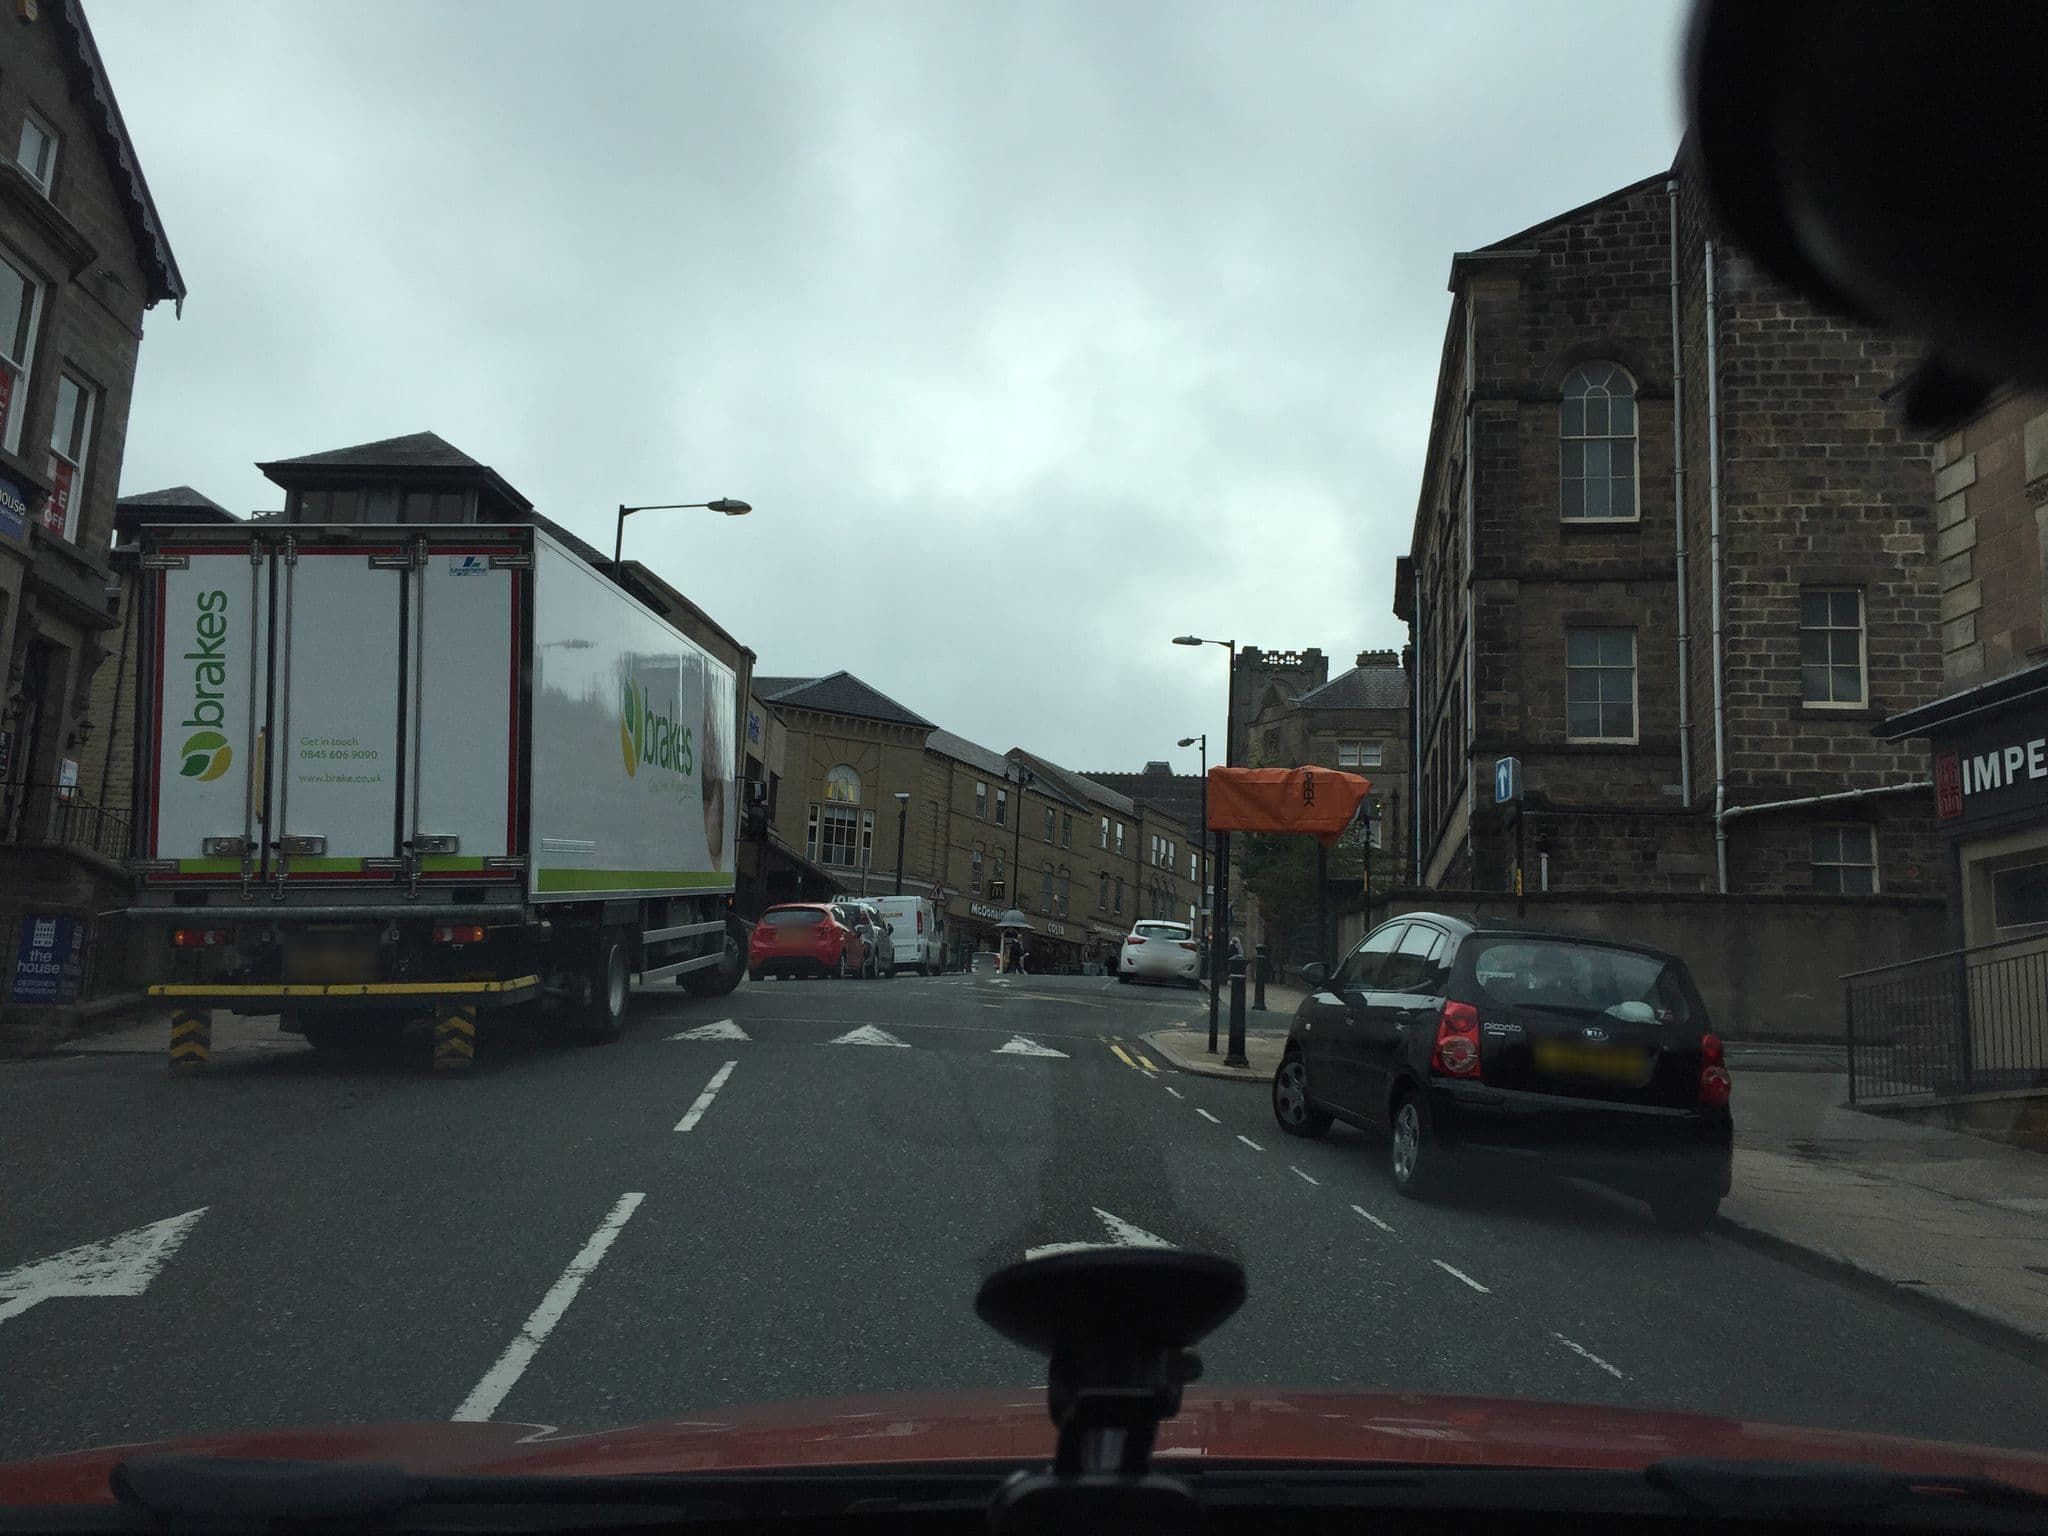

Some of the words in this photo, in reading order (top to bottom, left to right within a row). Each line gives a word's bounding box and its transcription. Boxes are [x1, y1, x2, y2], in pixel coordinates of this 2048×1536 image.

[181, 590, 228, 729] brakes
[643, 686, 693, 776] brakes
[300, 737, 317, 746] Get
[331, 736, 358, 746] touch
[300, 750, 327, 759] 0845
[329, 750, 349, 760] 606
[351, 750, 378, 760] 9090
[1962, 738, 2048, 795] IMPE
[299, 774, 382, 784] www.brake.co.uk
[1303, 772, 1315, 808] PEEK
[1047, 922, 1065, 936] COSTA
[30, 949, 52, 962] the
[17, 960, 60, 975] house
[1585, 1030, 1605, 1039] KIA
